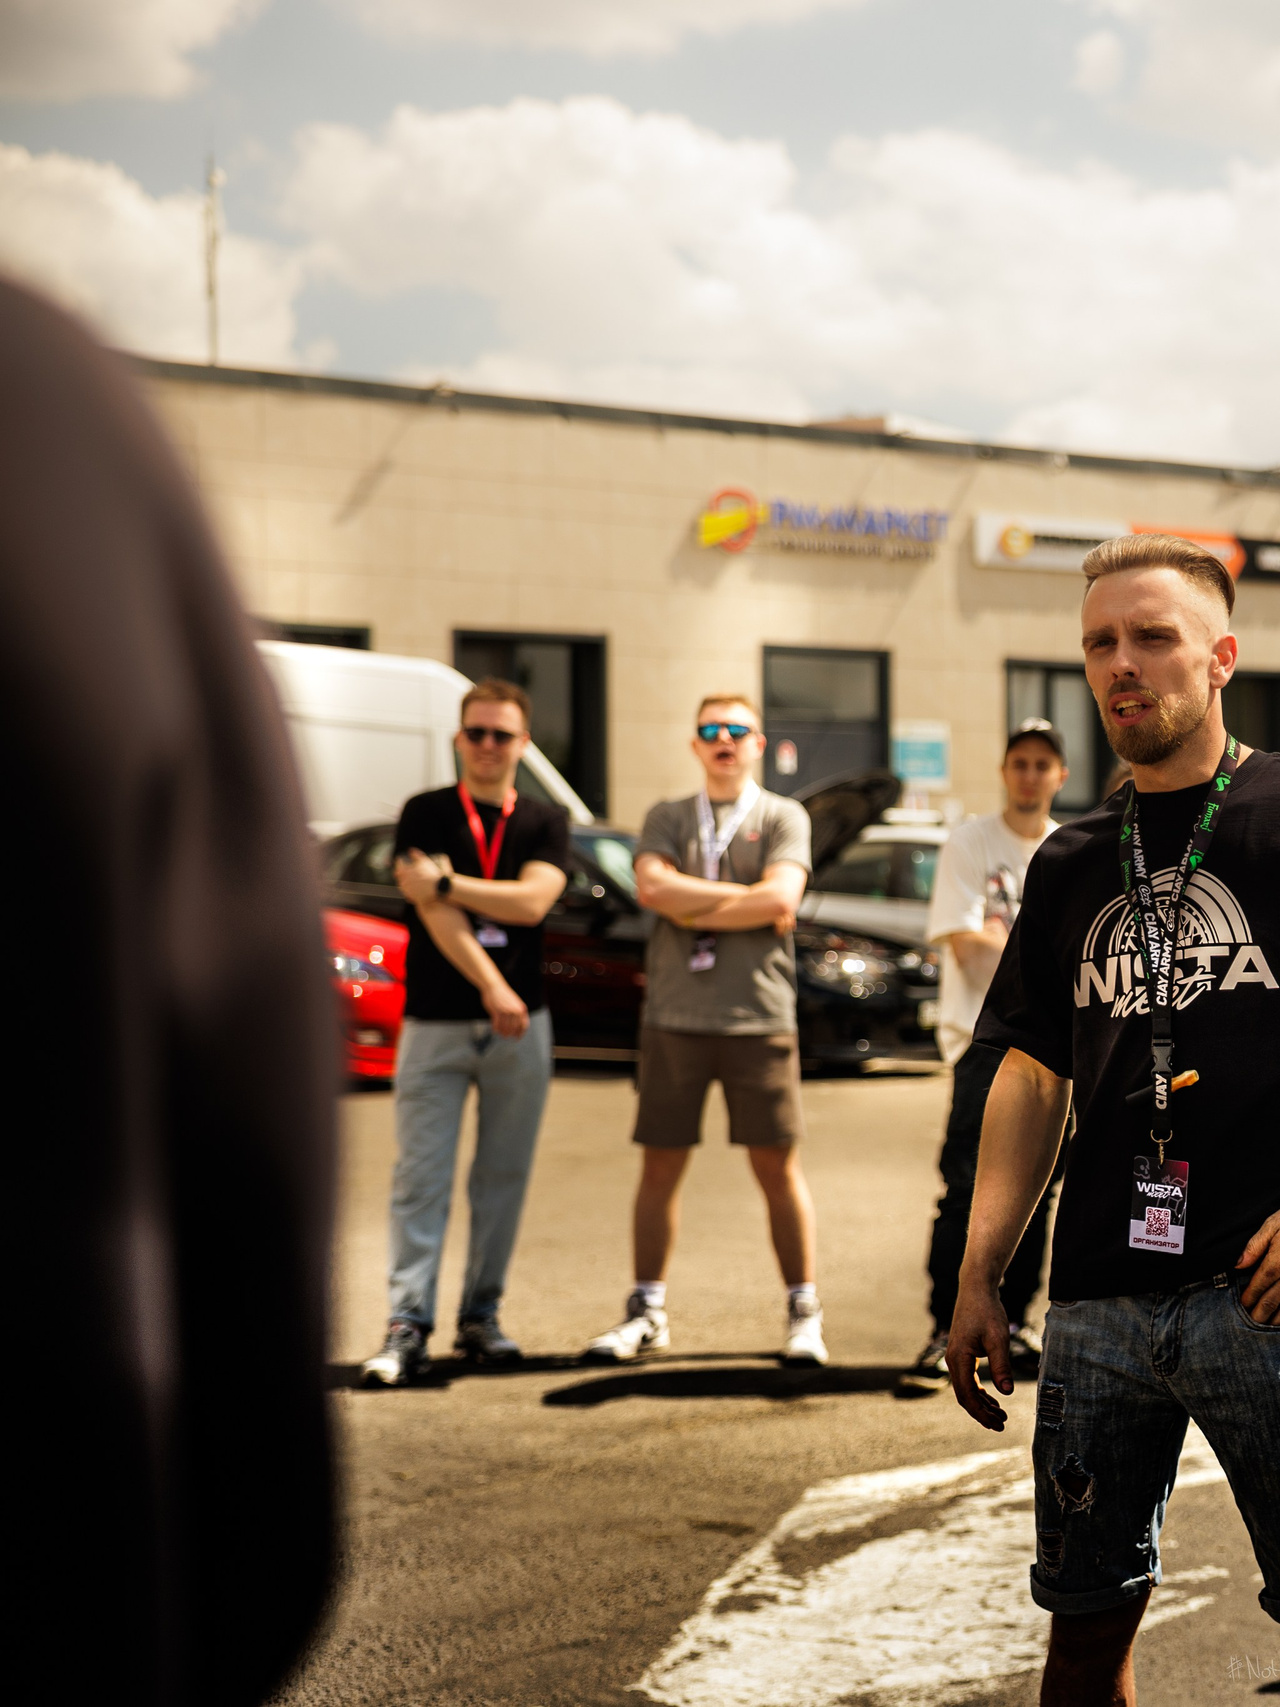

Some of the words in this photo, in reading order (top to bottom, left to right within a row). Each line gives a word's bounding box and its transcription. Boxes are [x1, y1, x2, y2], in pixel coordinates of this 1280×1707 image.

[1133, 848, 1147, 879] ARMY
[1149, 940, 1161, 973] ARM
[1160, 937, 1173, 976] ARMY
[1111, 966, 1216, 1018] met
[1136, 1181, 1183, 1198] WISTA
[1133, 1237, 1180, 1249] ОРГАНИЗАТОР
